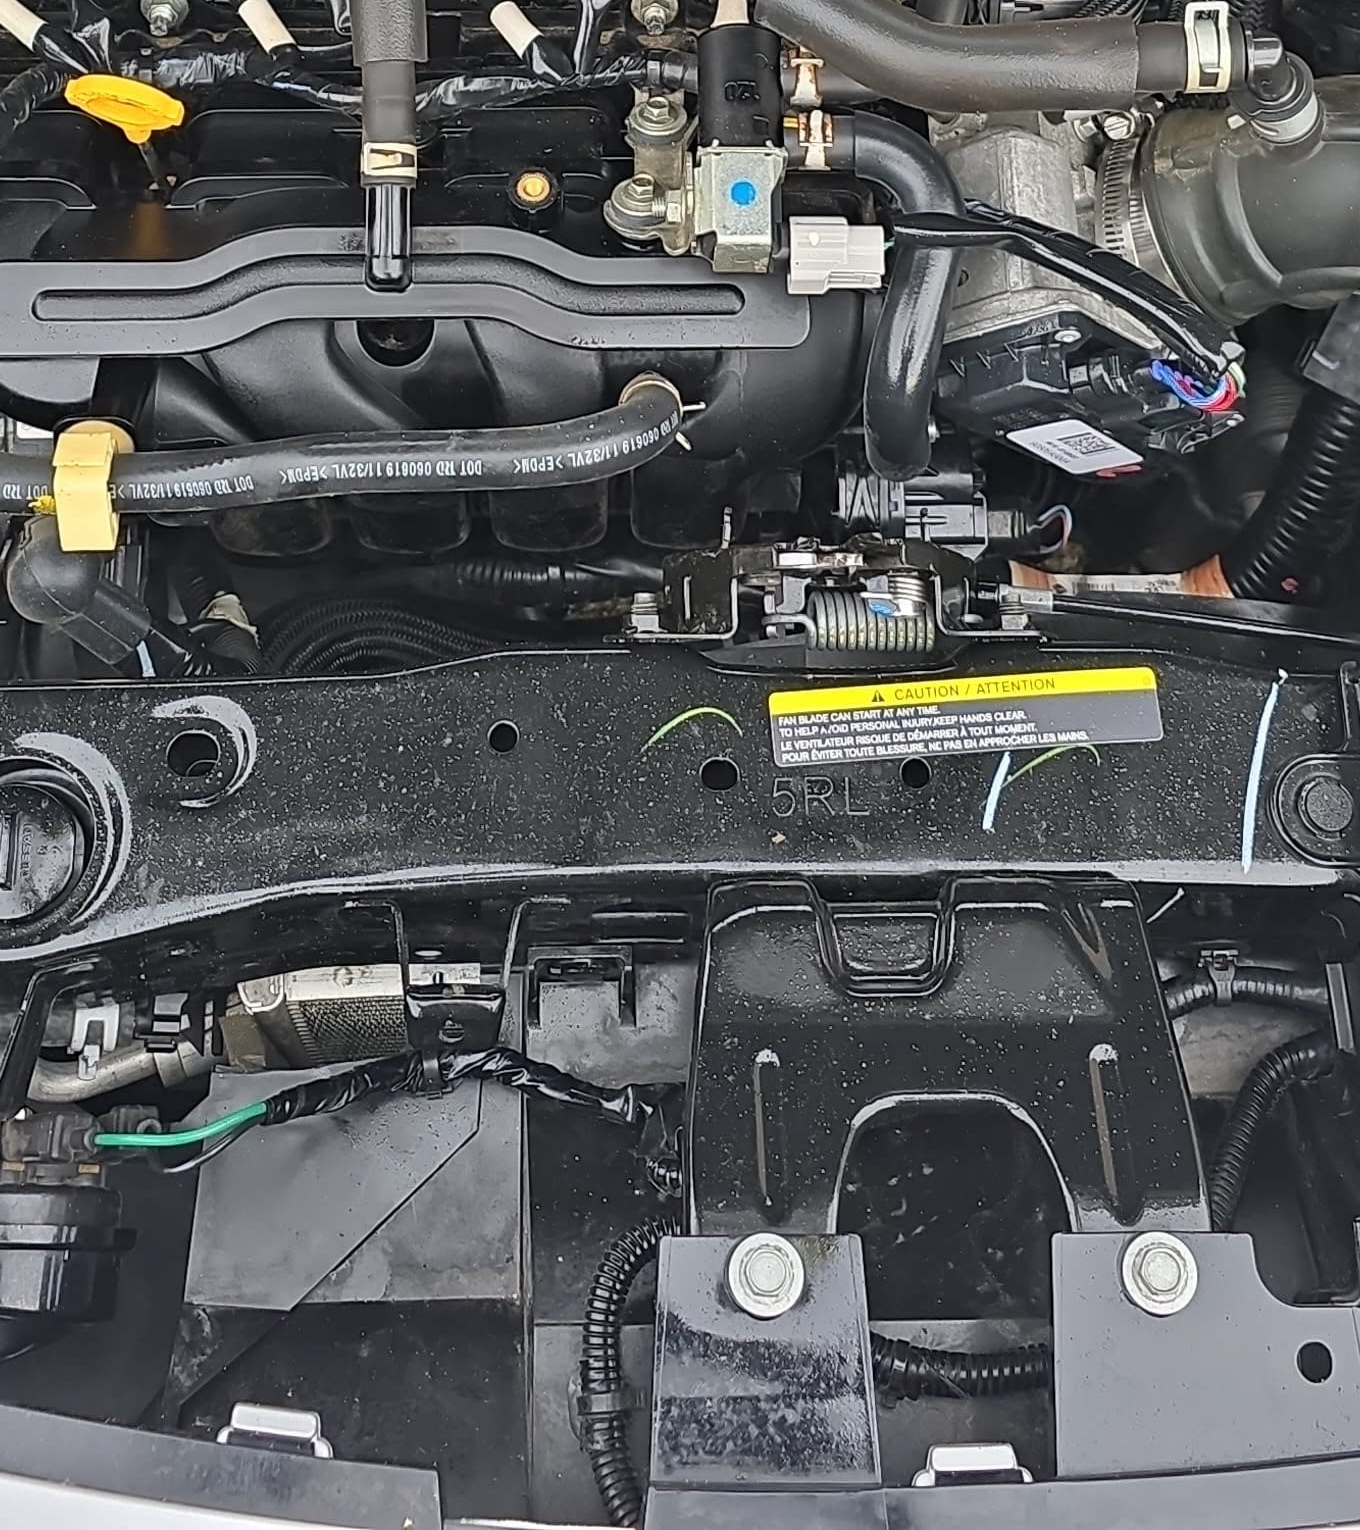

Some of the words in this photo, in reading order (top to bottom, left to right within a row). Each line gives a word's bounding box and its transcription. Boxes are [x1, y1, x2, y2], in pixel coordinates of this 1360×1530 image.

[622, 426, 659, 454] 060619
[386, 462, 431, 477] 060619
[461, 460, 482, 475] DOT
[174, 481, 211, 497] 060619
[234, 476, 254, 492] DOT
[894, 686, 959, 701] CAUTION
[976, 678, 1055, 695] ATTENTION
[778, 716, 797, 726] FAN
[798, 714, 829, 725] BLADE
[830, 712, 851, 722] CAN
[853, 710, 882, 721] START
[884, 709, 894, 718] AT
[896, 708, 916, 717] ANY
[918, 706, 941, 715] TIME.
[780, 728, 793, 738] TO
[795, 727, 818, 737] HELP
[851, 720, 900, 732] PERSONAL
[959, 713, 993, 723] HANDS
[994, 711, 1027, 721] CLEAR.
[781, 742, 792, 751] LE
[794, 736, 854, 749] VENTILATEUR
[856, 734, 891, 745] RISQUE
[893, 732, 906, 742] DE
[908, 726, 958, 740] DÉMARRER
[960, 724, 968, 736] À
[970, 725, 993, 736] TOUT
[994, 722, 1038, 734] MOMENT.
[782, 752, 809, 763] POUR
[812, 748, 843, 760] ÉVITER
[844, 746, 875, 757] TOUTE
[877, 742, 927, 755] BLESSURE,
[944, 740, 962, 750] PAS
[964, 738, 977, 749] EN
[978, 734, 1037, 748] APPROCHER
[1039, 733, 1055, 743] LES
[1057, 731, 1089, 741] MAINS.
[772, 776, 870, 816] 5RL
